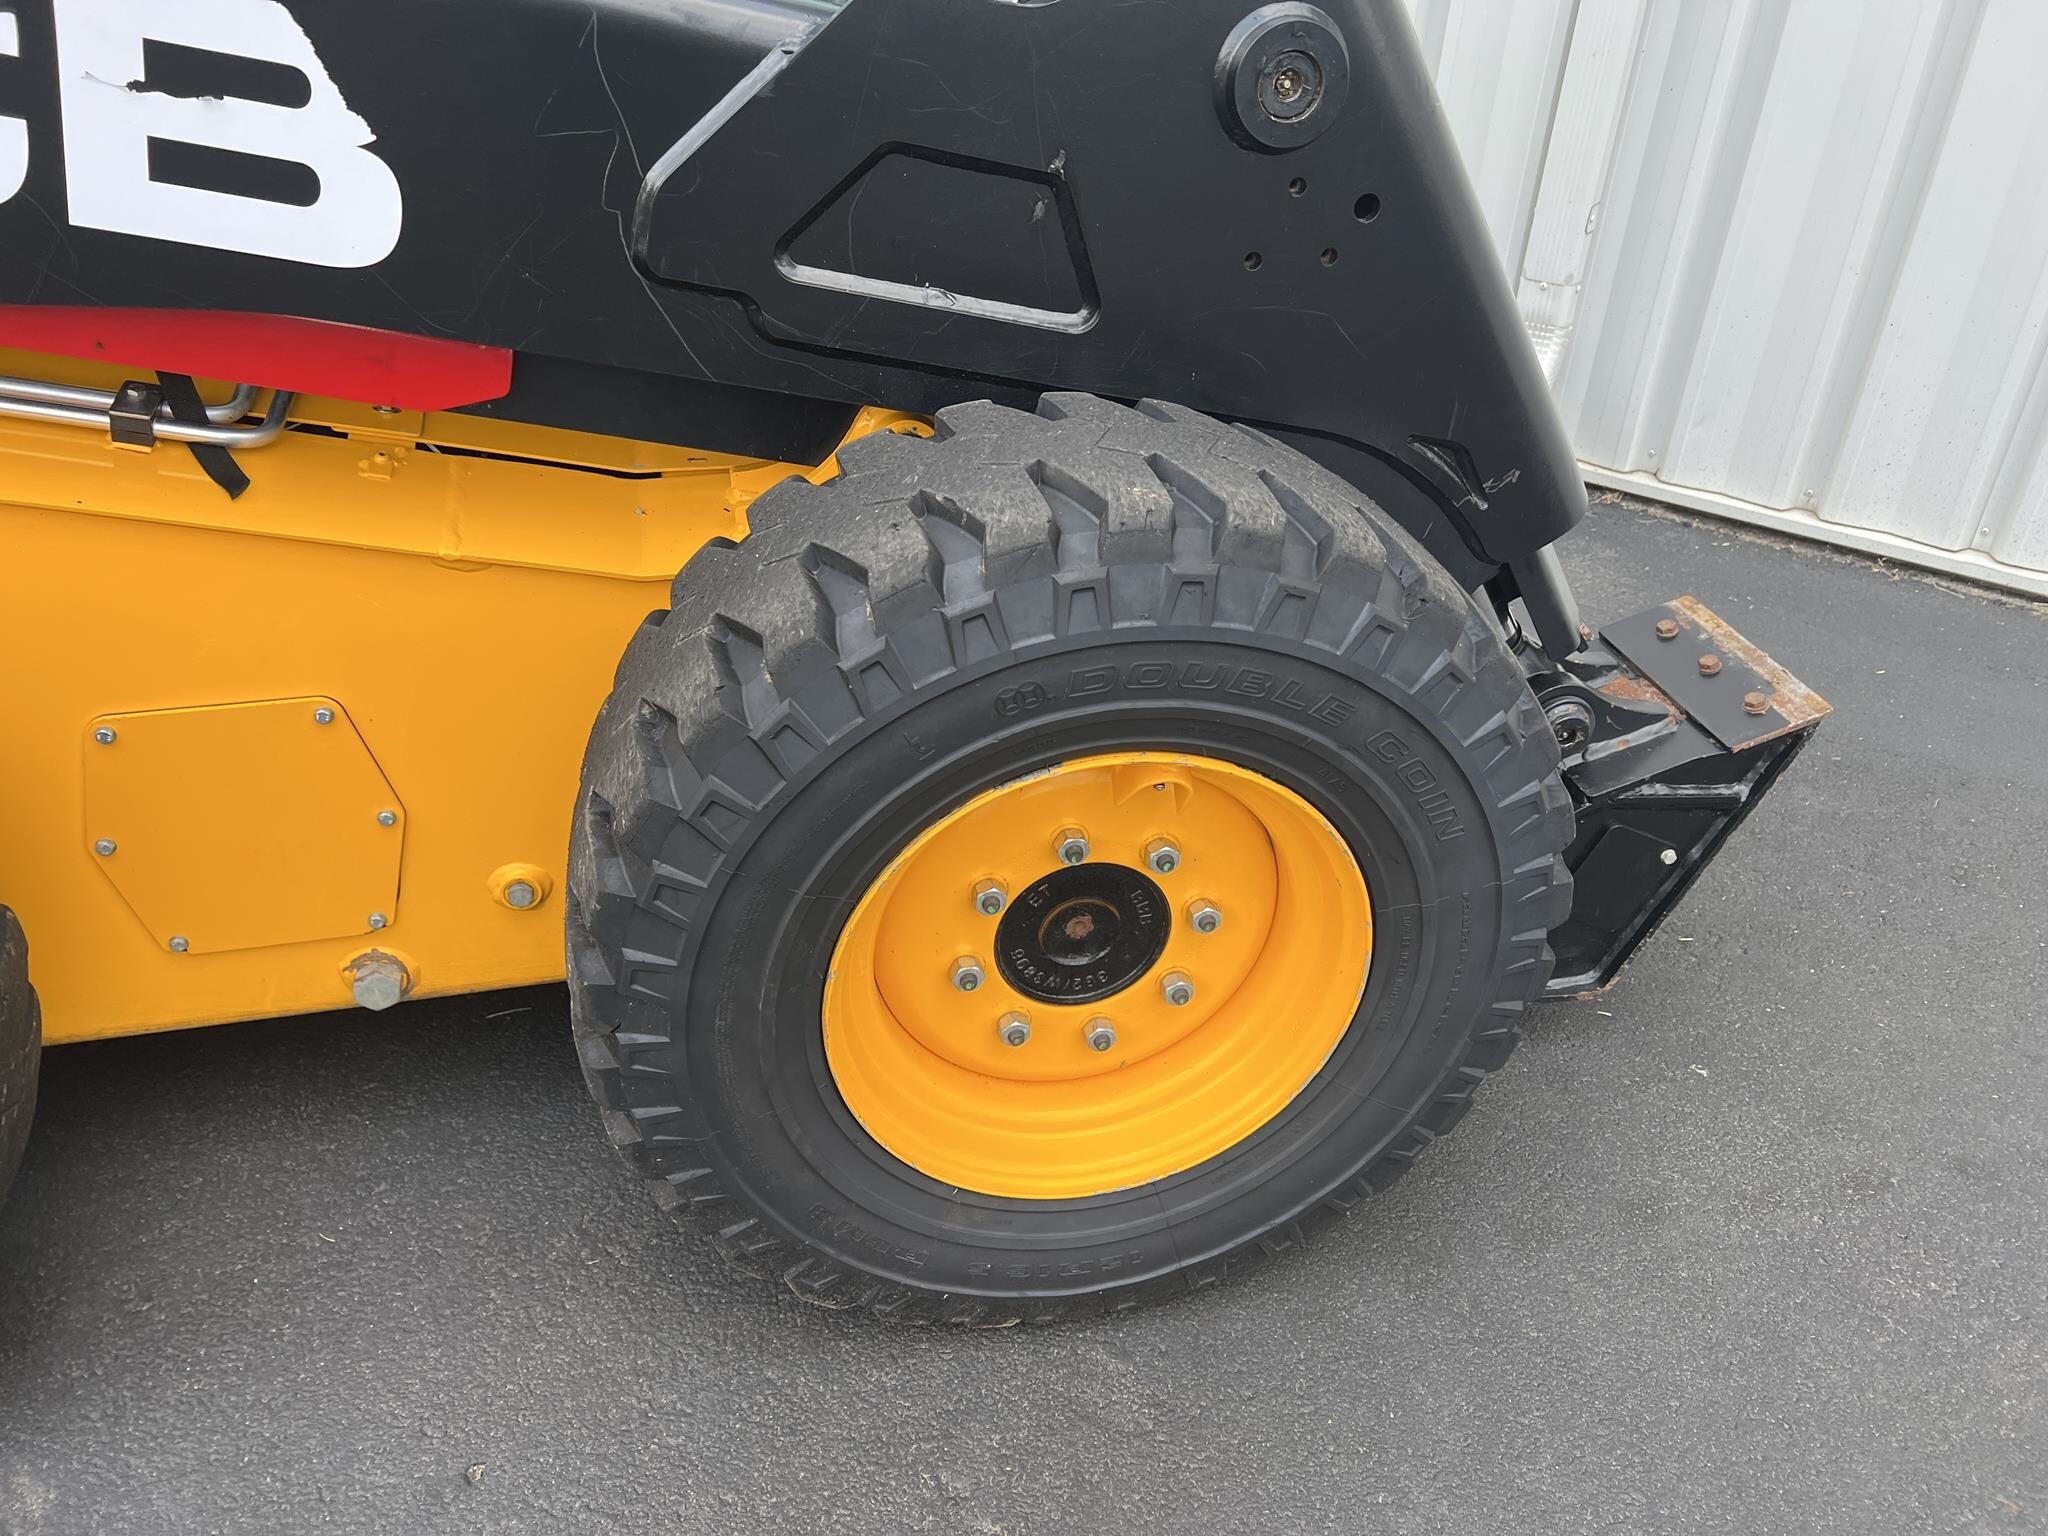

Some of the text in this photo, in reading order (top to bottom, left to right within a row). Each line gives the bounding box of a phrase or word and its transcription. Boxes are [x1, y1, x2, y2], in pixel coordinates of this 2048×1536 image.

[0, 0, 403, 269] B
[1067, 660, 1467, 843] DOUBLE COIN
